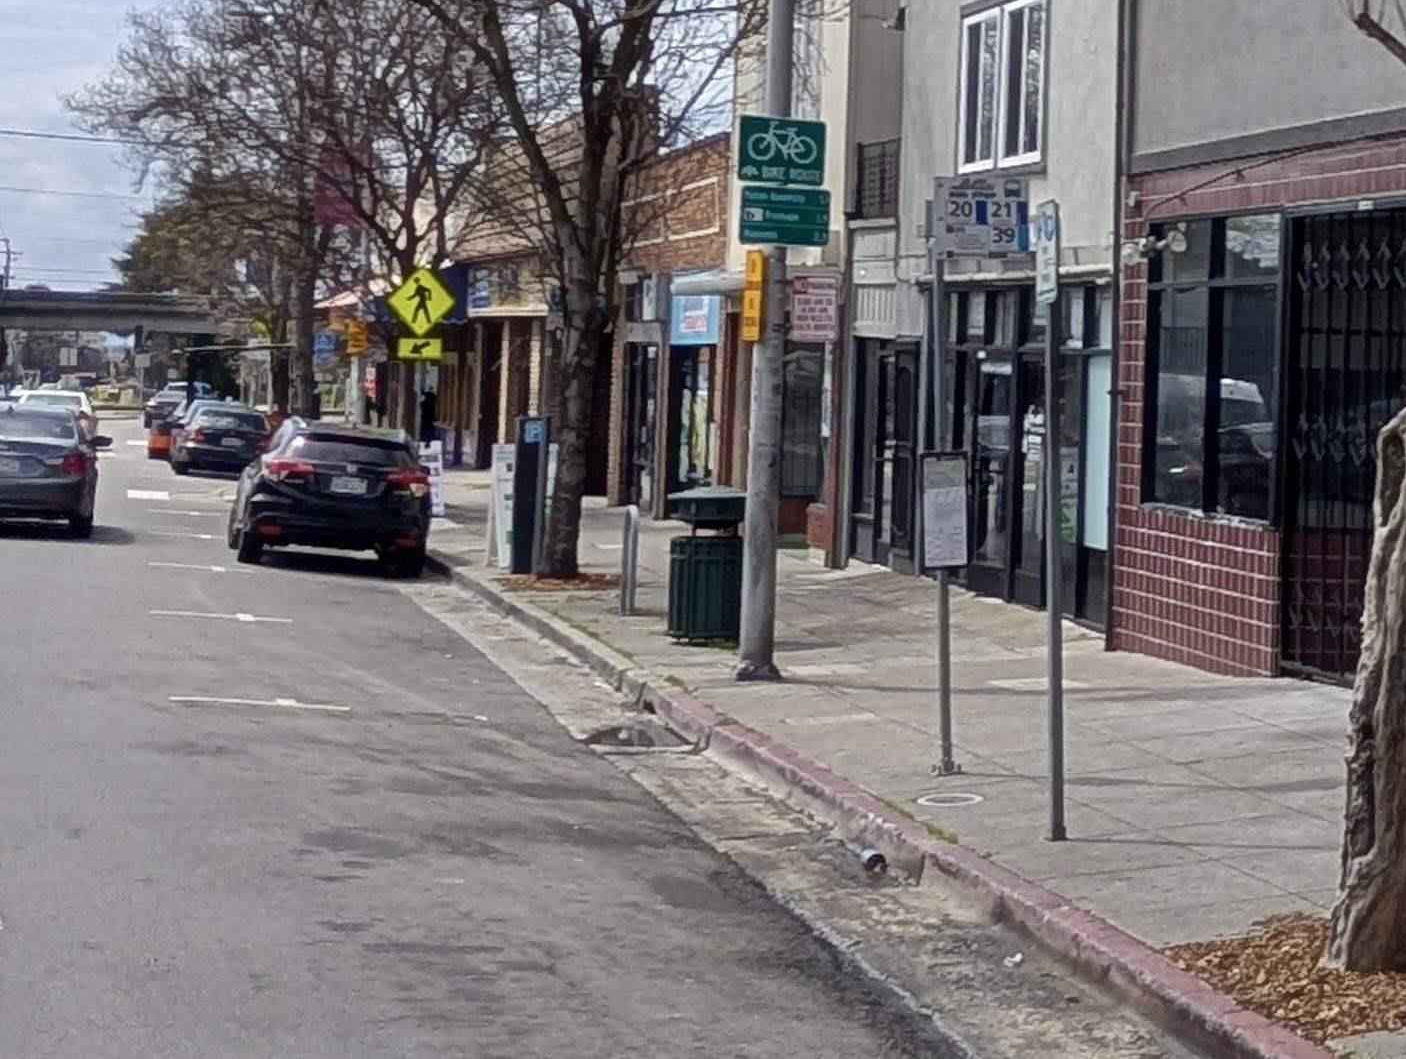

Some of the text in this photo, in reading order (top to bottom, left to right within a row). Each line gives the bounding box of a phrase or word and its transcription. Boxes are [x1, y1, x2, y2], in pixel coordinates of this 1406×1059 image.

[950, 201, 1012, 218] 20 21
[992, 227, 1015, 244] 39
